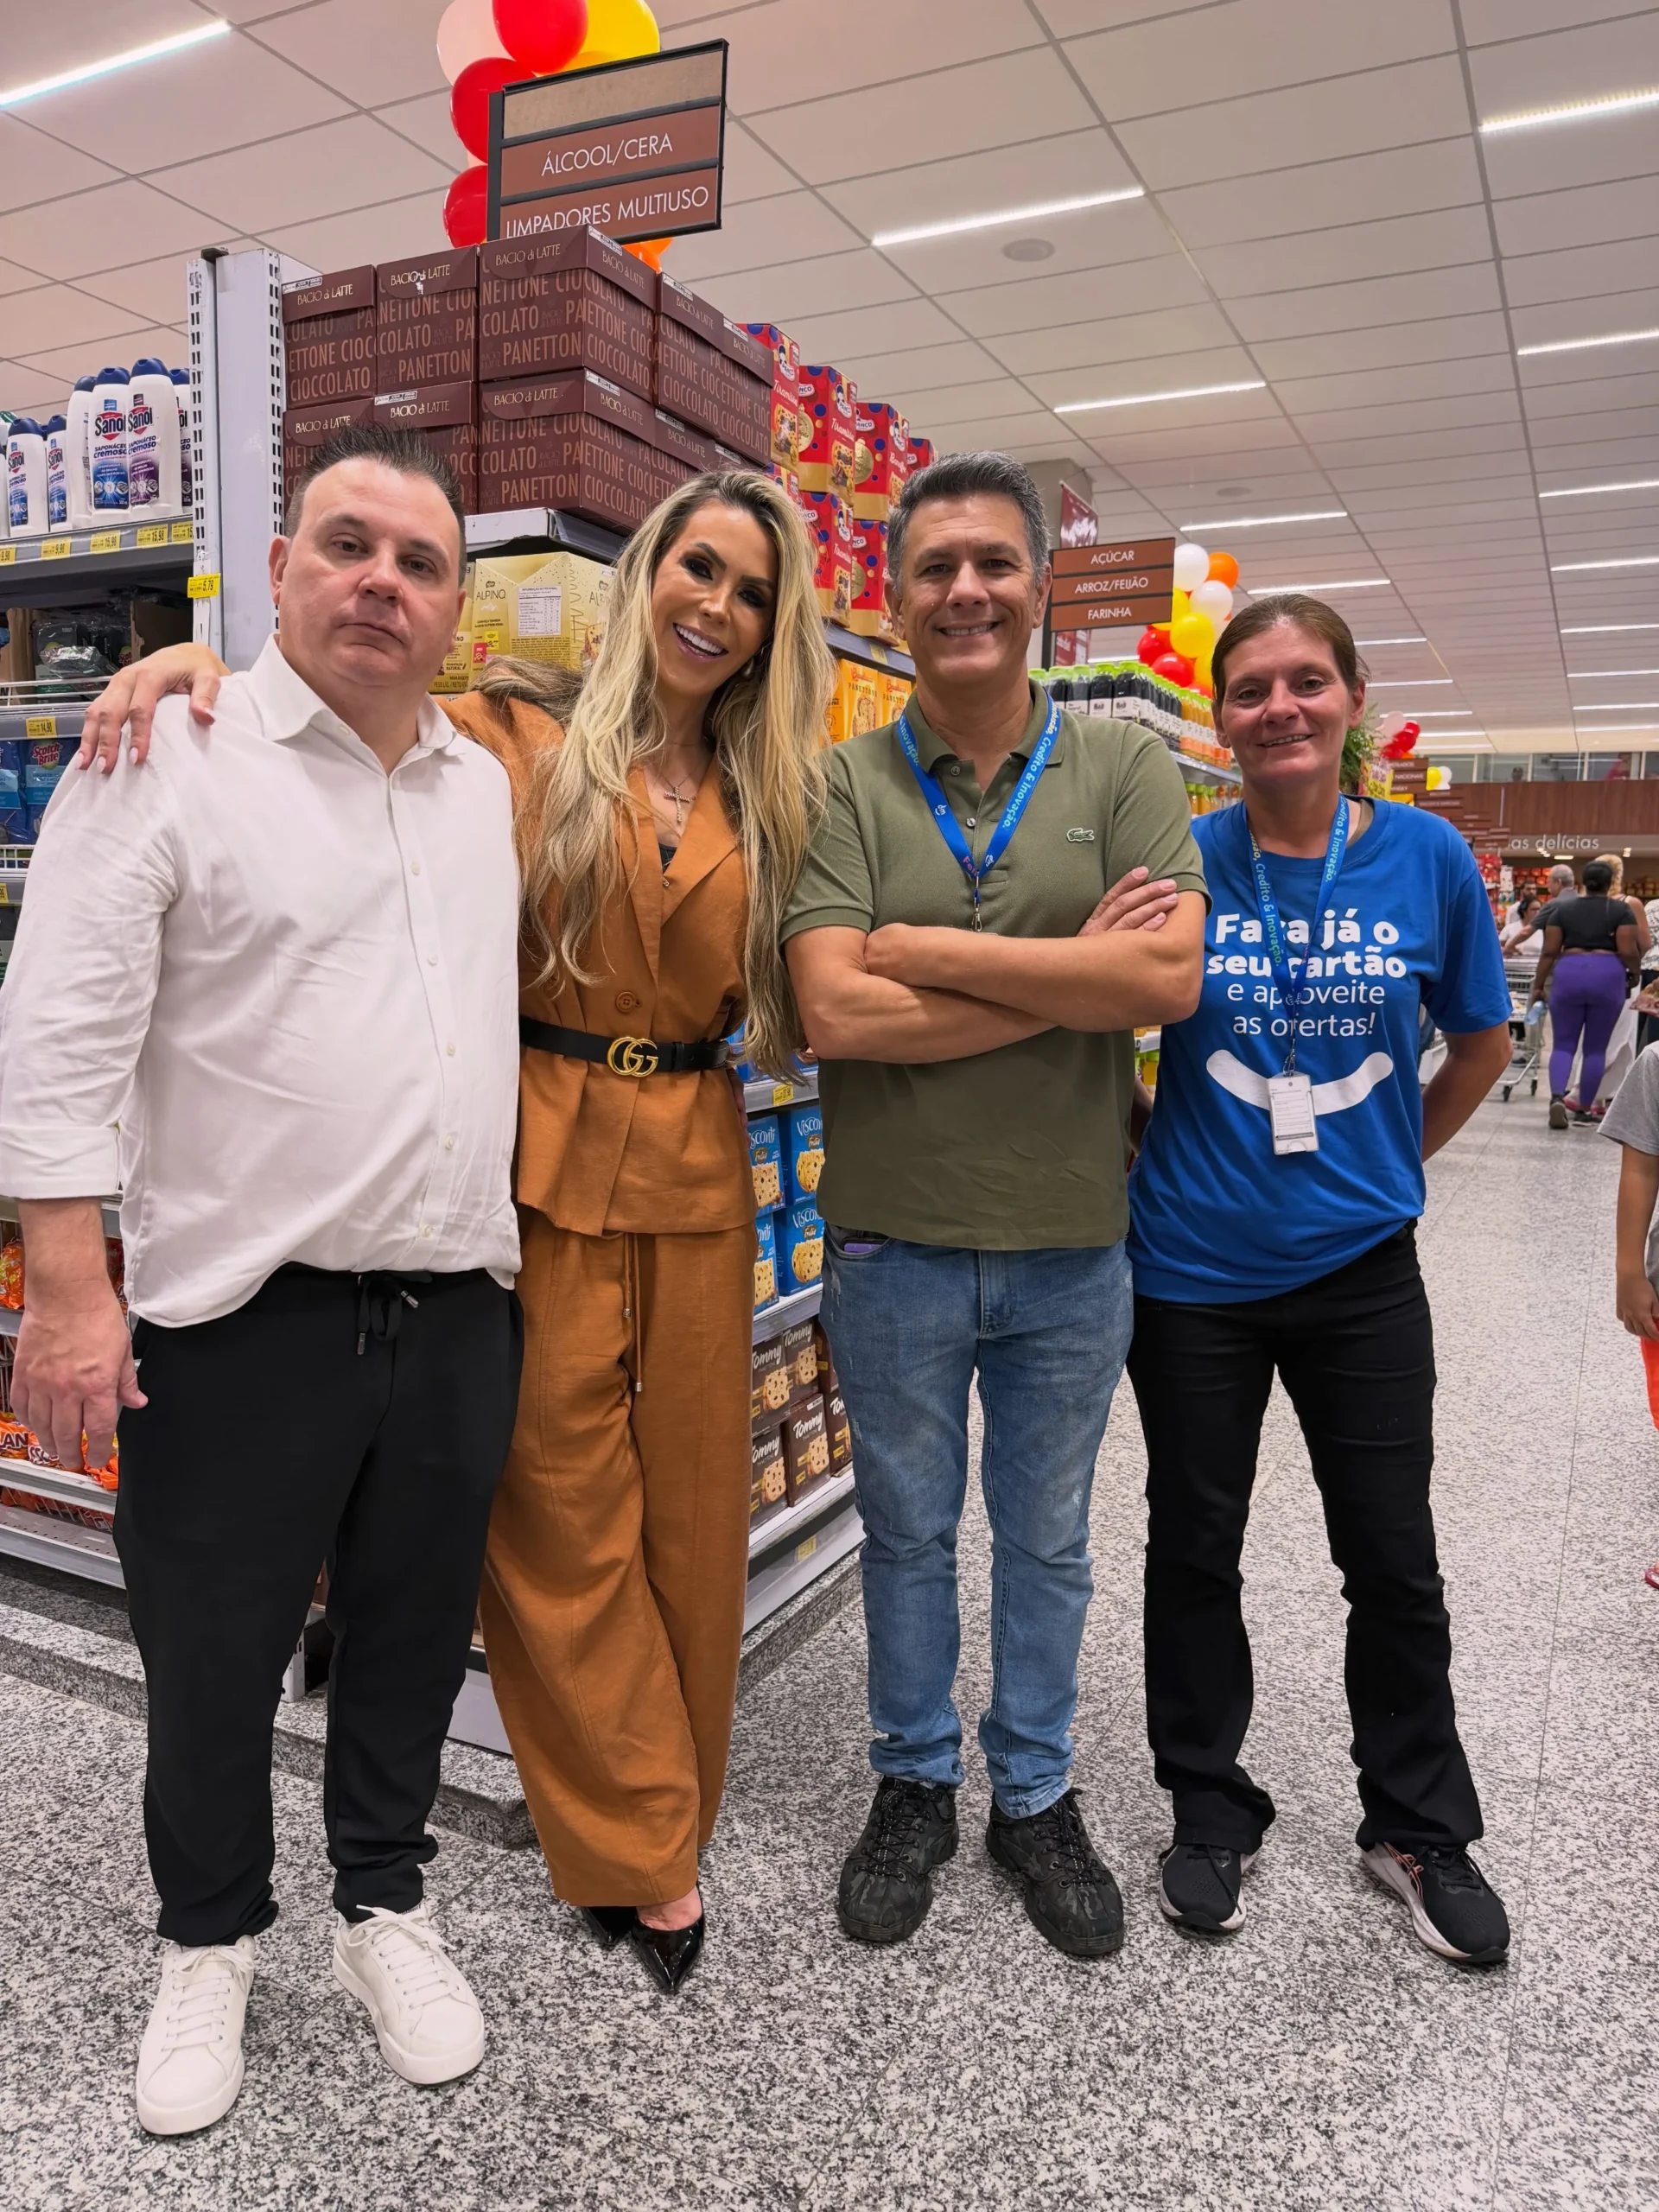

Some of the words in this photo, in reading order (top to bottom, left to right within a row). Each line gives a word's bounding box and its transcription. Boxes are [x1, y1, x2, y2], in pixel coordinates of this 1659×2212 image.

[542, 133, 673, 175] ÁLCOOL/CERA
[506, 203, 611, 238] LIMPADORES
[617, 186, 709, 220] MULTIUSO
[495, 251, 525, 266] BACIO
[536, 244, 561, 259] LATTE
[391, 270, 417, 286] BACIO
[297, 289, 322, 306] BACIO
[331, 283, 353, 298] LATTE
[588, 333, 649, 389] CIOCCOLATO
[289, 366, 371, 402] CIOCCOLATO
[493, 391, 524, 406] BACIO
[533, 388, 558, 401] LATTE
[600, 393, 621, 413] BACIO
[663, 374, 719, 425] CIOCCOLATO
[128, 407, 153, 432] Sanol
[391, 403, 417, 418] BACIO
[427, 400, 450, 413] LATTE
[95, 415, 126, 436] Sanol
[584, 474, 646, 521] CIOCCOLATO
[1090, 550, 1135, 566] AÇÚCAR
[476, 589, 506, 601] ALPINO
[1075, 576, 1148, 594] ARROZ/FEIJÃO
[1088, 607, 1132, 620] FARINHA
[38, 752, 60, 766] Brite
[1535, 833, 1599, 850] delícias
[1320, 908, 1361, 950] já
[1373, 921, 1400, 945] o
[1206, 954, 1272, 978] seu
[1287, 945, 1407, 978] cartão
[1227, 983, 1244, 1001] e
[1253, 979, 1385, 1010] apoveite
[1232, 1015, 1262, 1034] as
[783, 1324, 812, 1347] Tommy
[753, 1344, 782, 1370] Tommy
[793, 1412, 823, 1440] Tommy
[752, 1436, 779, 1464] Tommy
